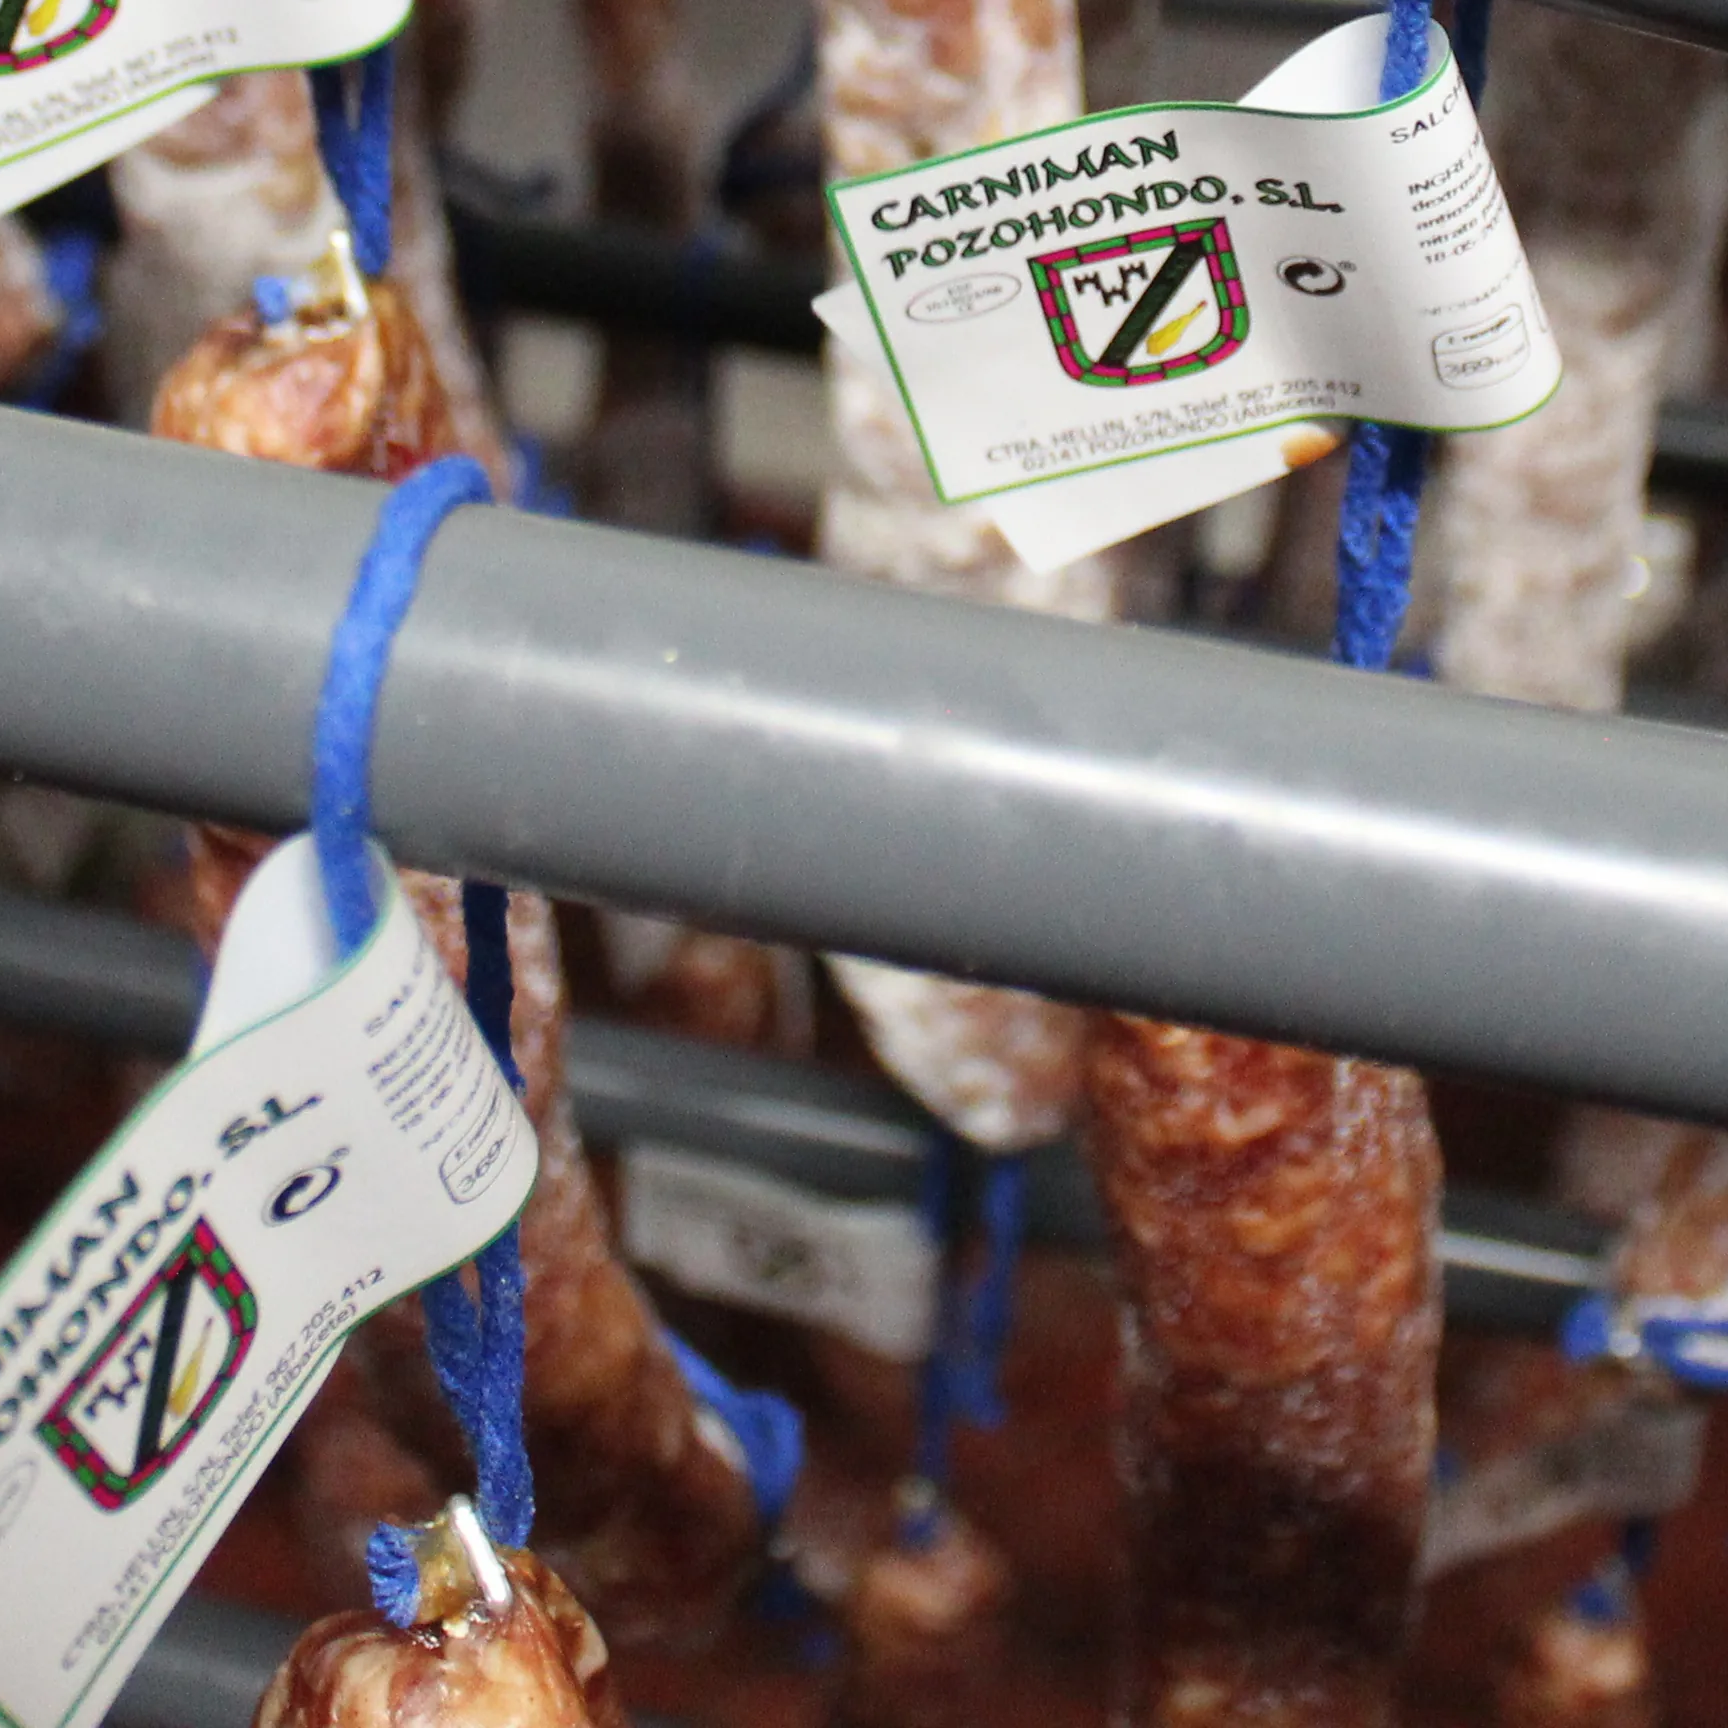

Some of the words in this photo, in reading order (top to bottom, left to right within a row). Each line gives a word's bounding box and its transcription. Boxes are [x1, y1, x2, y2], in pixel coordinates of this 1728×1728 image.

[872, 130, 1179, 235] CARNIMAN
[1254, 177, 1346, 213] S.L.
[265, 1341, 297, 1386] 967
[300, 1299, 337, 1346] 205
[341, 1268, 386, 1302] 412
[267, 1303, 359, 1411] (Albacete)
